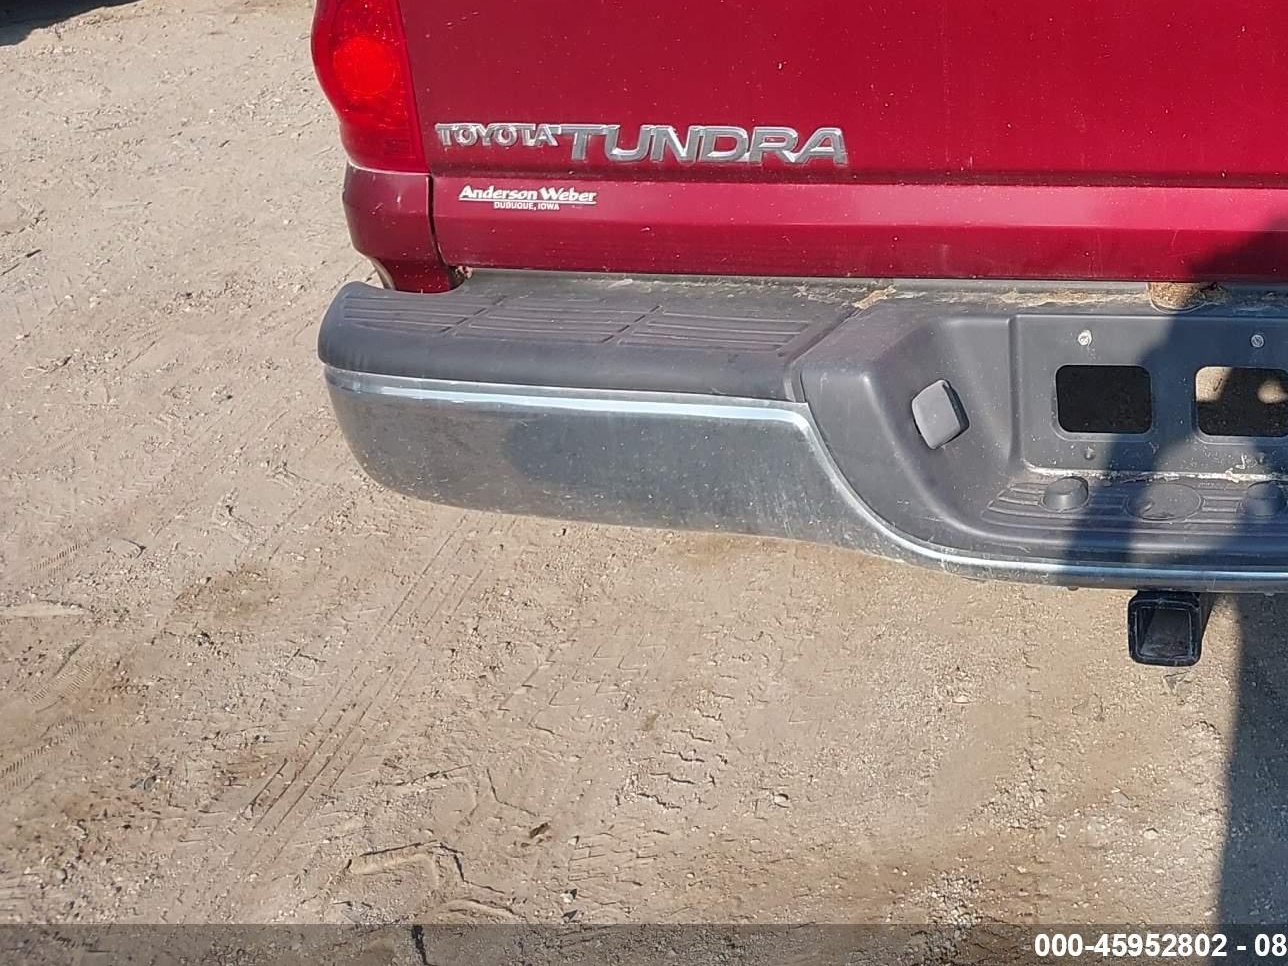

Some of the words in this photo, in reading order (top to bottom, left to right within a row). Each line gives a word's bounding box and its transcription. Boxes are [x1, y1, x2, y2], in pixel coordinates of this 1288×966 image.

[434, 122, 560, 146] TOYOTA
[561, 123, 849, 166] TUNDRA
[459, 185, 537, 200] Anderson
[539, 187, 597, 202] Weber
[538, 202, 560, 211] IOWA
